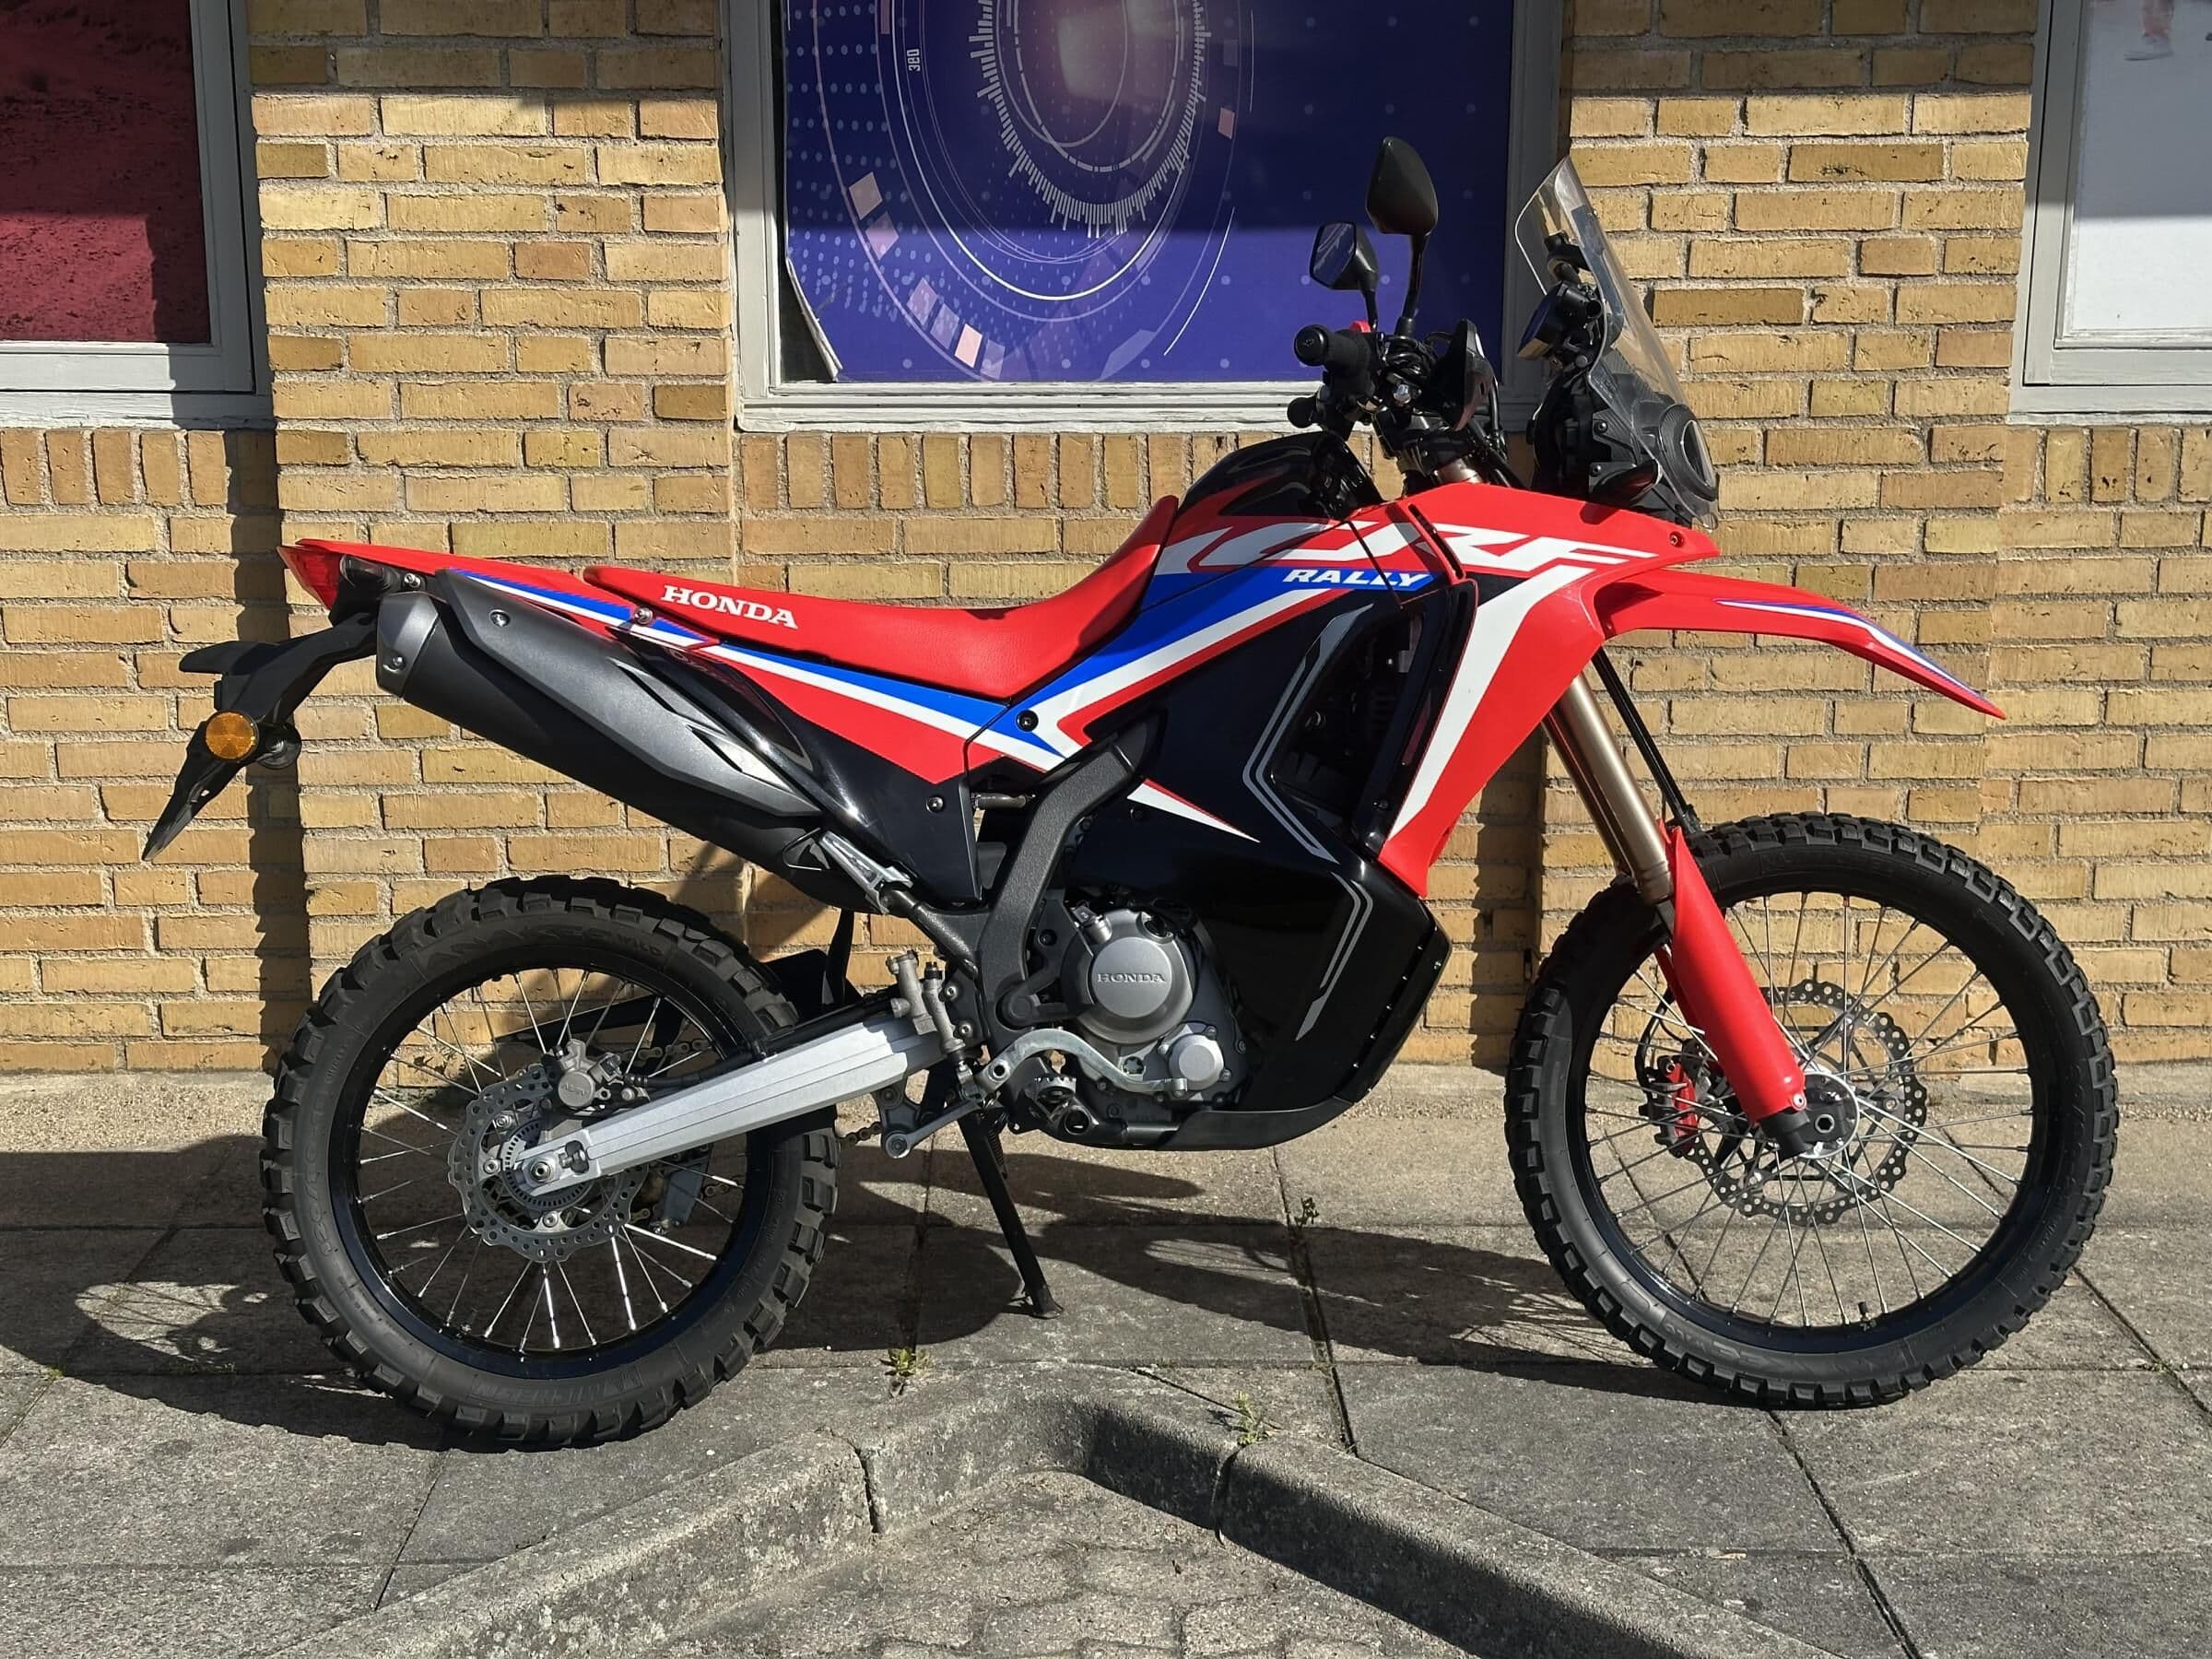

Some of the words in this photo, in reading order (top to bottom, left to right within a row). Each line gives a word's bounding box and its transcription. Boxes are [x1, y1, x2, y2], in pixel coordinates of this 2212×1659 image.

[1282, 568, 1431, 588] RALLY
[661, 585, 799, 629] HONDA
[1097, 973, 1166, 983] HONDA
